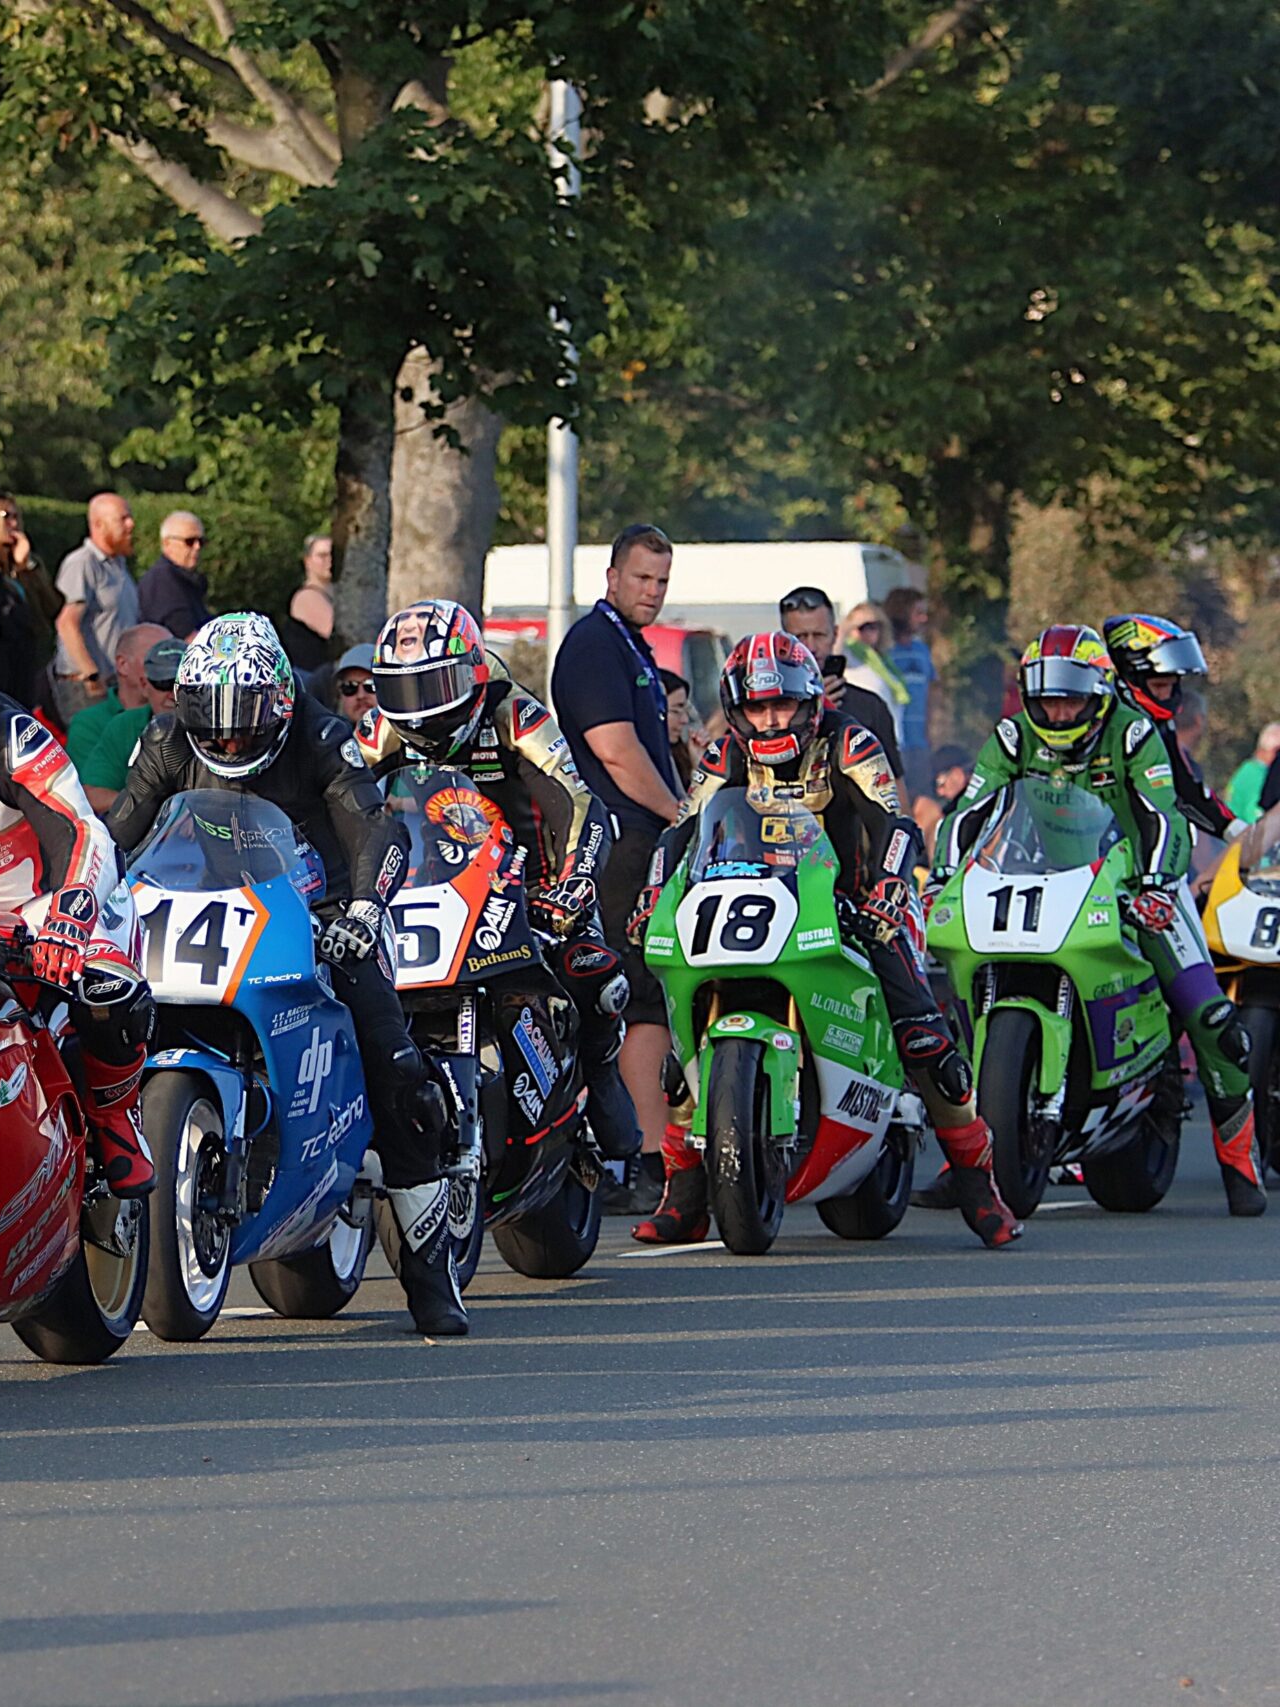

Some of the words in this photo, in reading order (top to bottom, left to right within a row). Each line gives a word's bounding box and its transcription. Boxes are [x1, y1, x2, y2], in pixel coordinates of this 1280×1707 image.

[483, 896, 510, 930] AIN
[690, 893, 777, 957] 18
[987, 884, 1045, 933] 11
[1249, 906, 1280, 956] 8
[138, 898, 230, 986] 14
[233, 906, 256, 927] T
[797, 927, 834, 942] MISTRAL
[86, 978, 127, 997] RST
[248, 977, 262, 985] TC
[264, 972, 303, 984] Racing
[460, 996, 473, 1054] MAXTON
[297, 1025, 334, 1115] dp
[300, 1130, 327, 1163] TC
